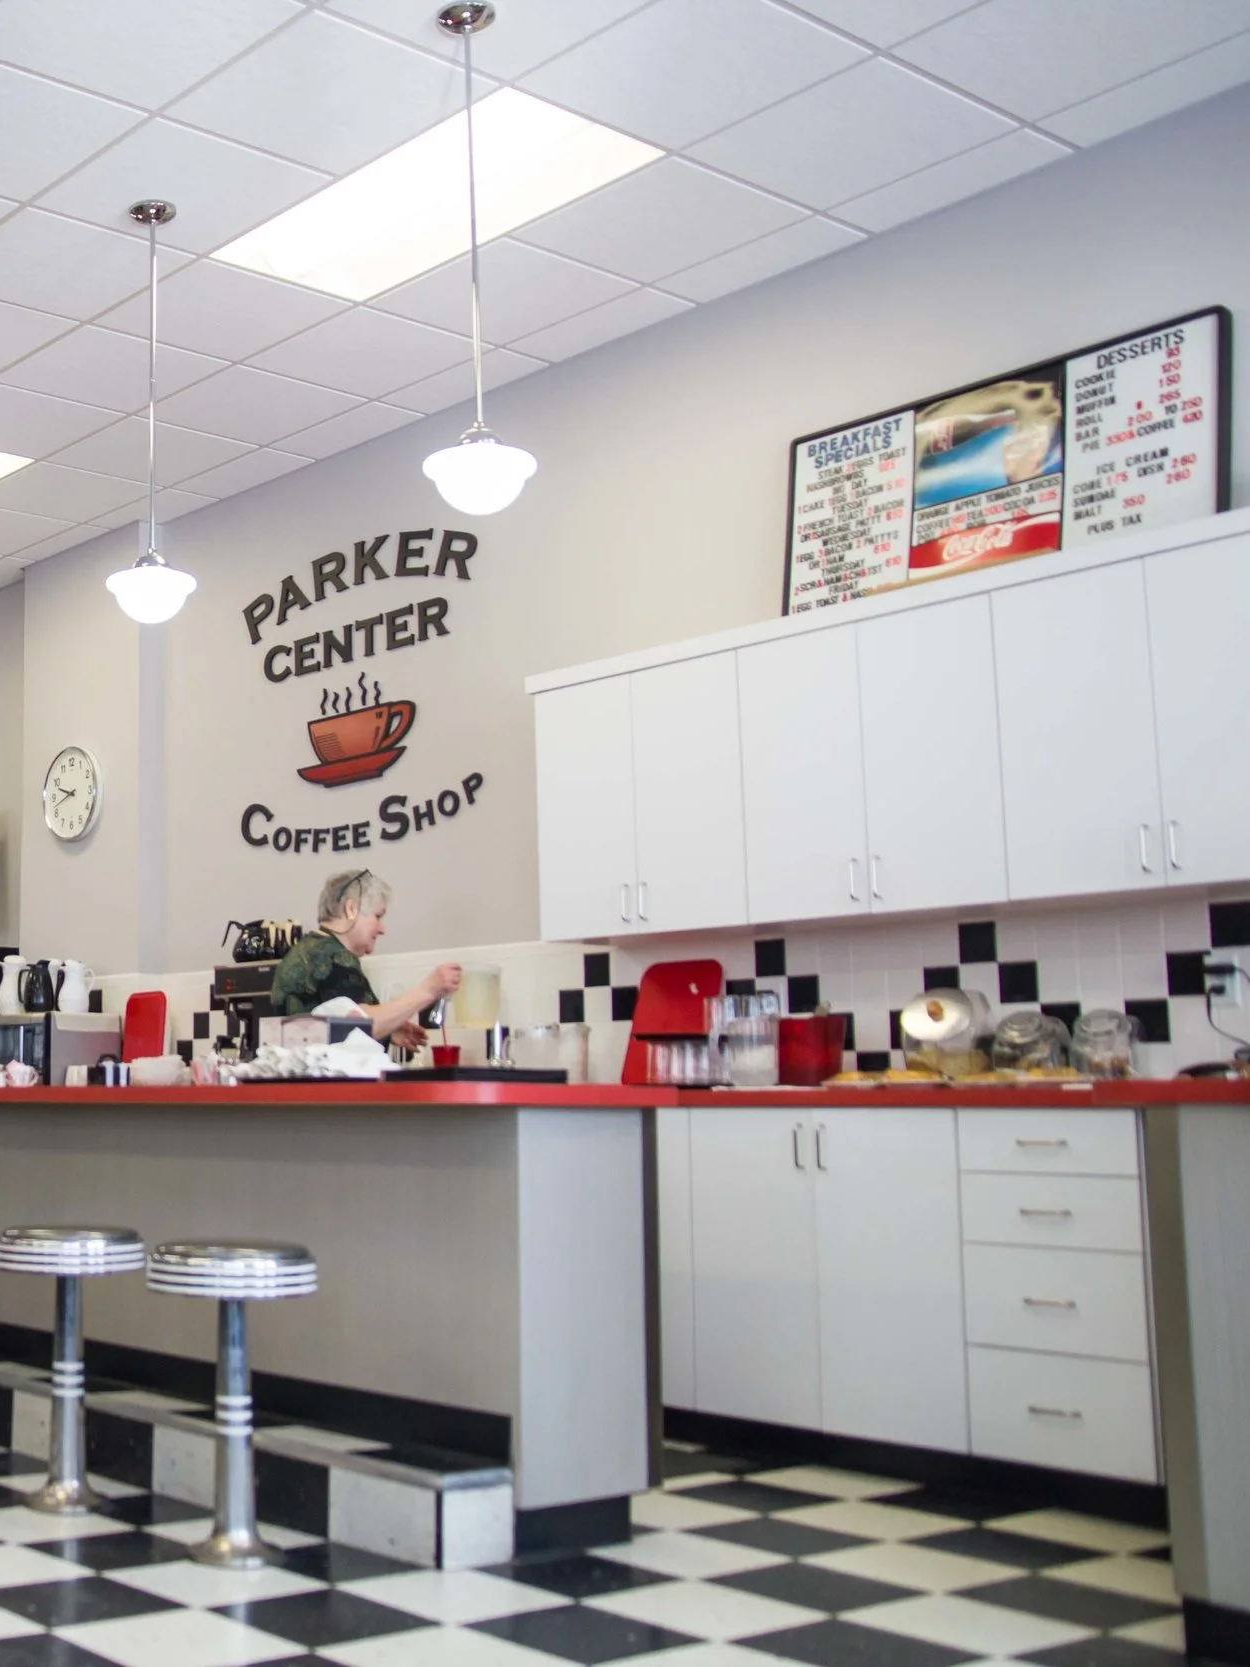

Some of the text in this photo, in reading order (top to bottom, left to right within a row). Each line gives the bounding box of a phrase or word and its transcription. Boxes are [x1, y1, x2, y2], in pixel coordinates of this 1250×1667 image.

[1097, 329, 1185, 369] DESSERTS
[1074, 369, 1115, 389] COOKIE
[1075, 382, 1113, 403] DONUT
[1076, 395, 1115, 415] MUFFIN
[807, 418, 902, 458] BREAKFAST
[1075, 426, 1100, 441] BAR
[814, 435, 892, 469] SPECIALS
[878, 447, 907, 461] TOAST
[1082, 440, 1100, 453] PIE
[1096, 447, 1168, 475] ICE CREAM
[954, 497, 981, 511] APPLE
[1024, 477, 1060, 493] JUICES
[1073, 479, 1102, 494] CONE
[832, 498, 868, 514] TUESDAY
[1073, 489, 1116, 508] SUNDAE
[838, 509, 864, 522] TOAST
[1073, 505, 1102, 521] MALT
[916, 517, 950, 534] COFFEE
[1087, 513, 1143, 535] PLUS TAX
[822, 527, 872, 547] WEDNESDAY
[821, 559, 865, 577] THURSDAY
[241, 527, 479, 646] PARKER
[829, 581, 859, 596] FRIDAY
[263, 596, 451, 684] CENTER
[60, 764, 66, 774] 11
[68, 757, 75, 767] 12
[78, 760, 83, 769] 1
[85, 769, 90, 779] 2
[54, 777, 61, 787] 10
[87, 785, 93, 795] 3
[51, 793, 56, 803] 9
[54, 808, 59, 818] 8
[85, 802, 90, 810] 4
[240, 771, 484, 853] COFFEE SHOP
[60, 818, 65, 828] 7
[69, 820, 74, 830] 6
[78, 814, 83, 824] 5
